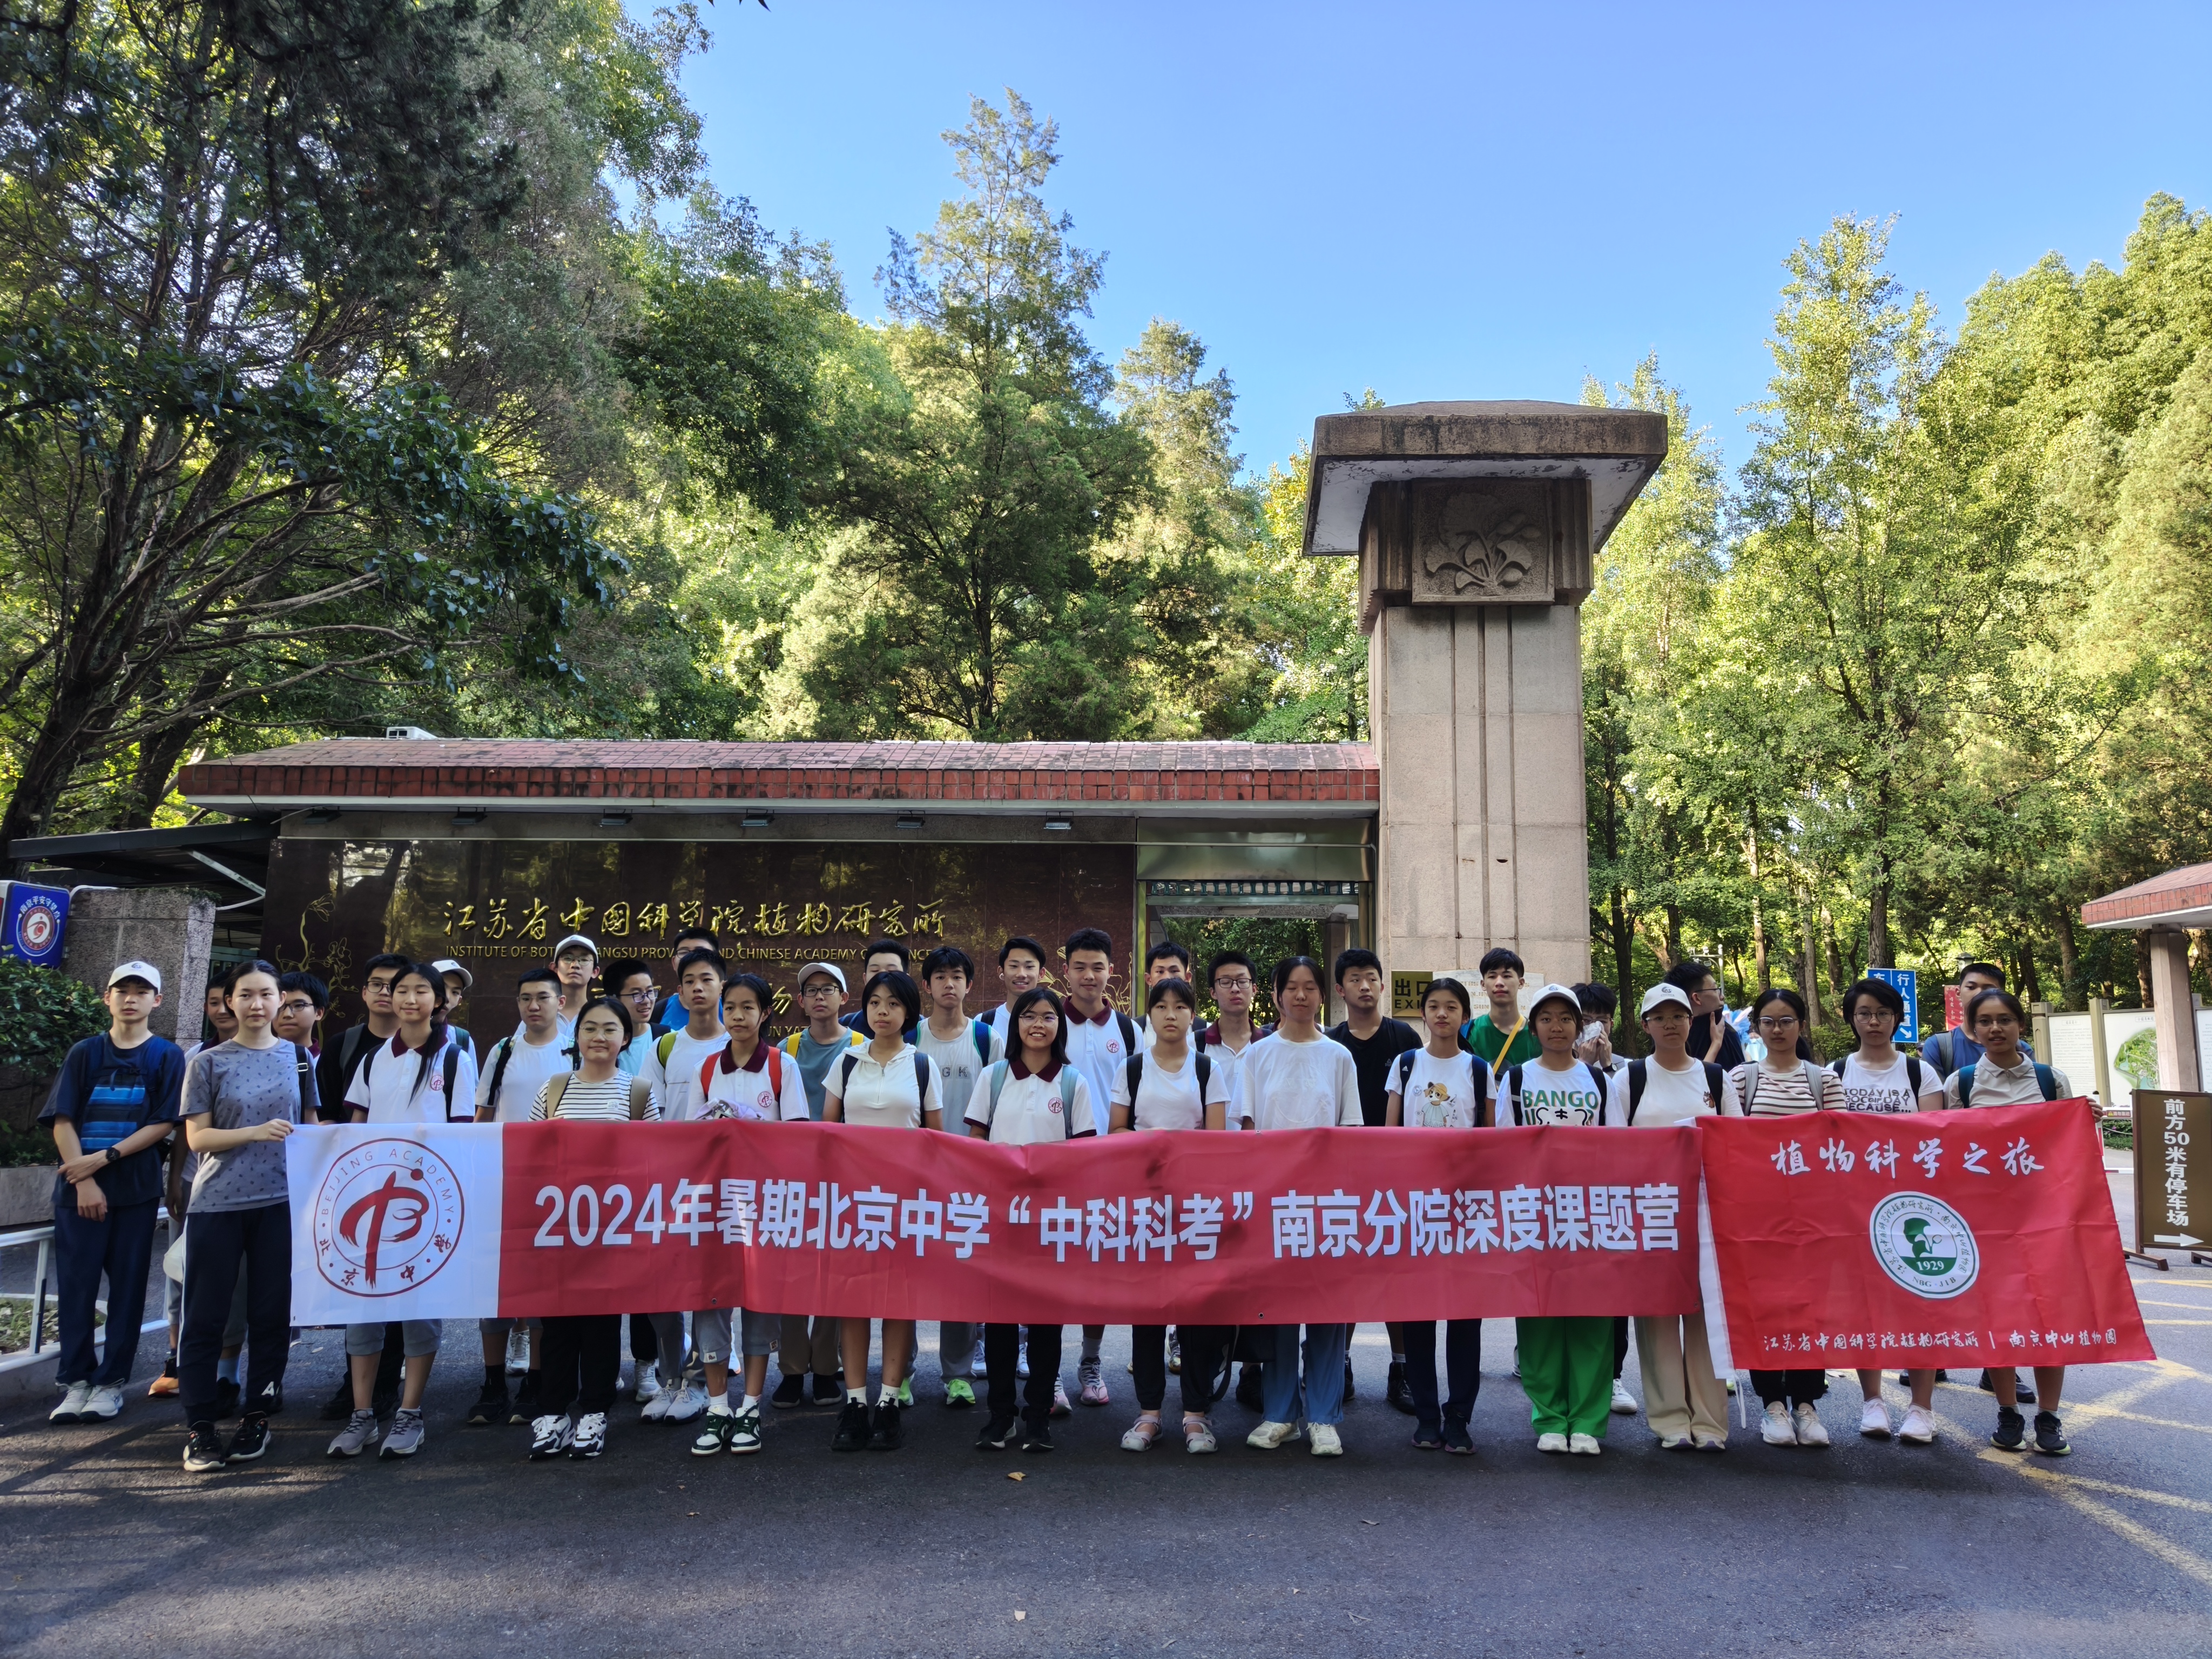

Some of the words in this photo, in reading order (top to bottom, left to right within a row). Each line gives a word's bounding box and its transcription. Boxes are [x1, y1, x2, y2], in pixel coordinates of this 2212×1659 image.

[446, 946, 507, 957] INSTITUTE
[511, 946, 527, 957] OF
[738, 948, 791, 960] CHINESE
[794, 948, 857, 960] ACADEMY
[1395, 979, 1431, 997] 出口
[1394, 1000, 1421, 1009] EXI
[958, 1066, 968, 1077] K
[1522, 1089, 1599, 1110] BANGO
[1844, 1089, 1884, 1097] TODAY
[1888, 1089, 1900, 1097] IS
[1903, 1089, 1910, 1098] A
[1884, 1096, 1910, 1105] DAY
[1770, 1137, 2045, 1179] 植物科学之旅
[2163, 1098, 2190, 1226] 前方50米有停车场
[321, 1151, 373, 1215] BEIJING
[389, 1148, 454, 1213] ACADEMY
[1916, 1260, 1945, 1271] 1929
[1912, 1276, 1932, 1287] NBG
[1939, 1277, 1956, 1287] JIB
